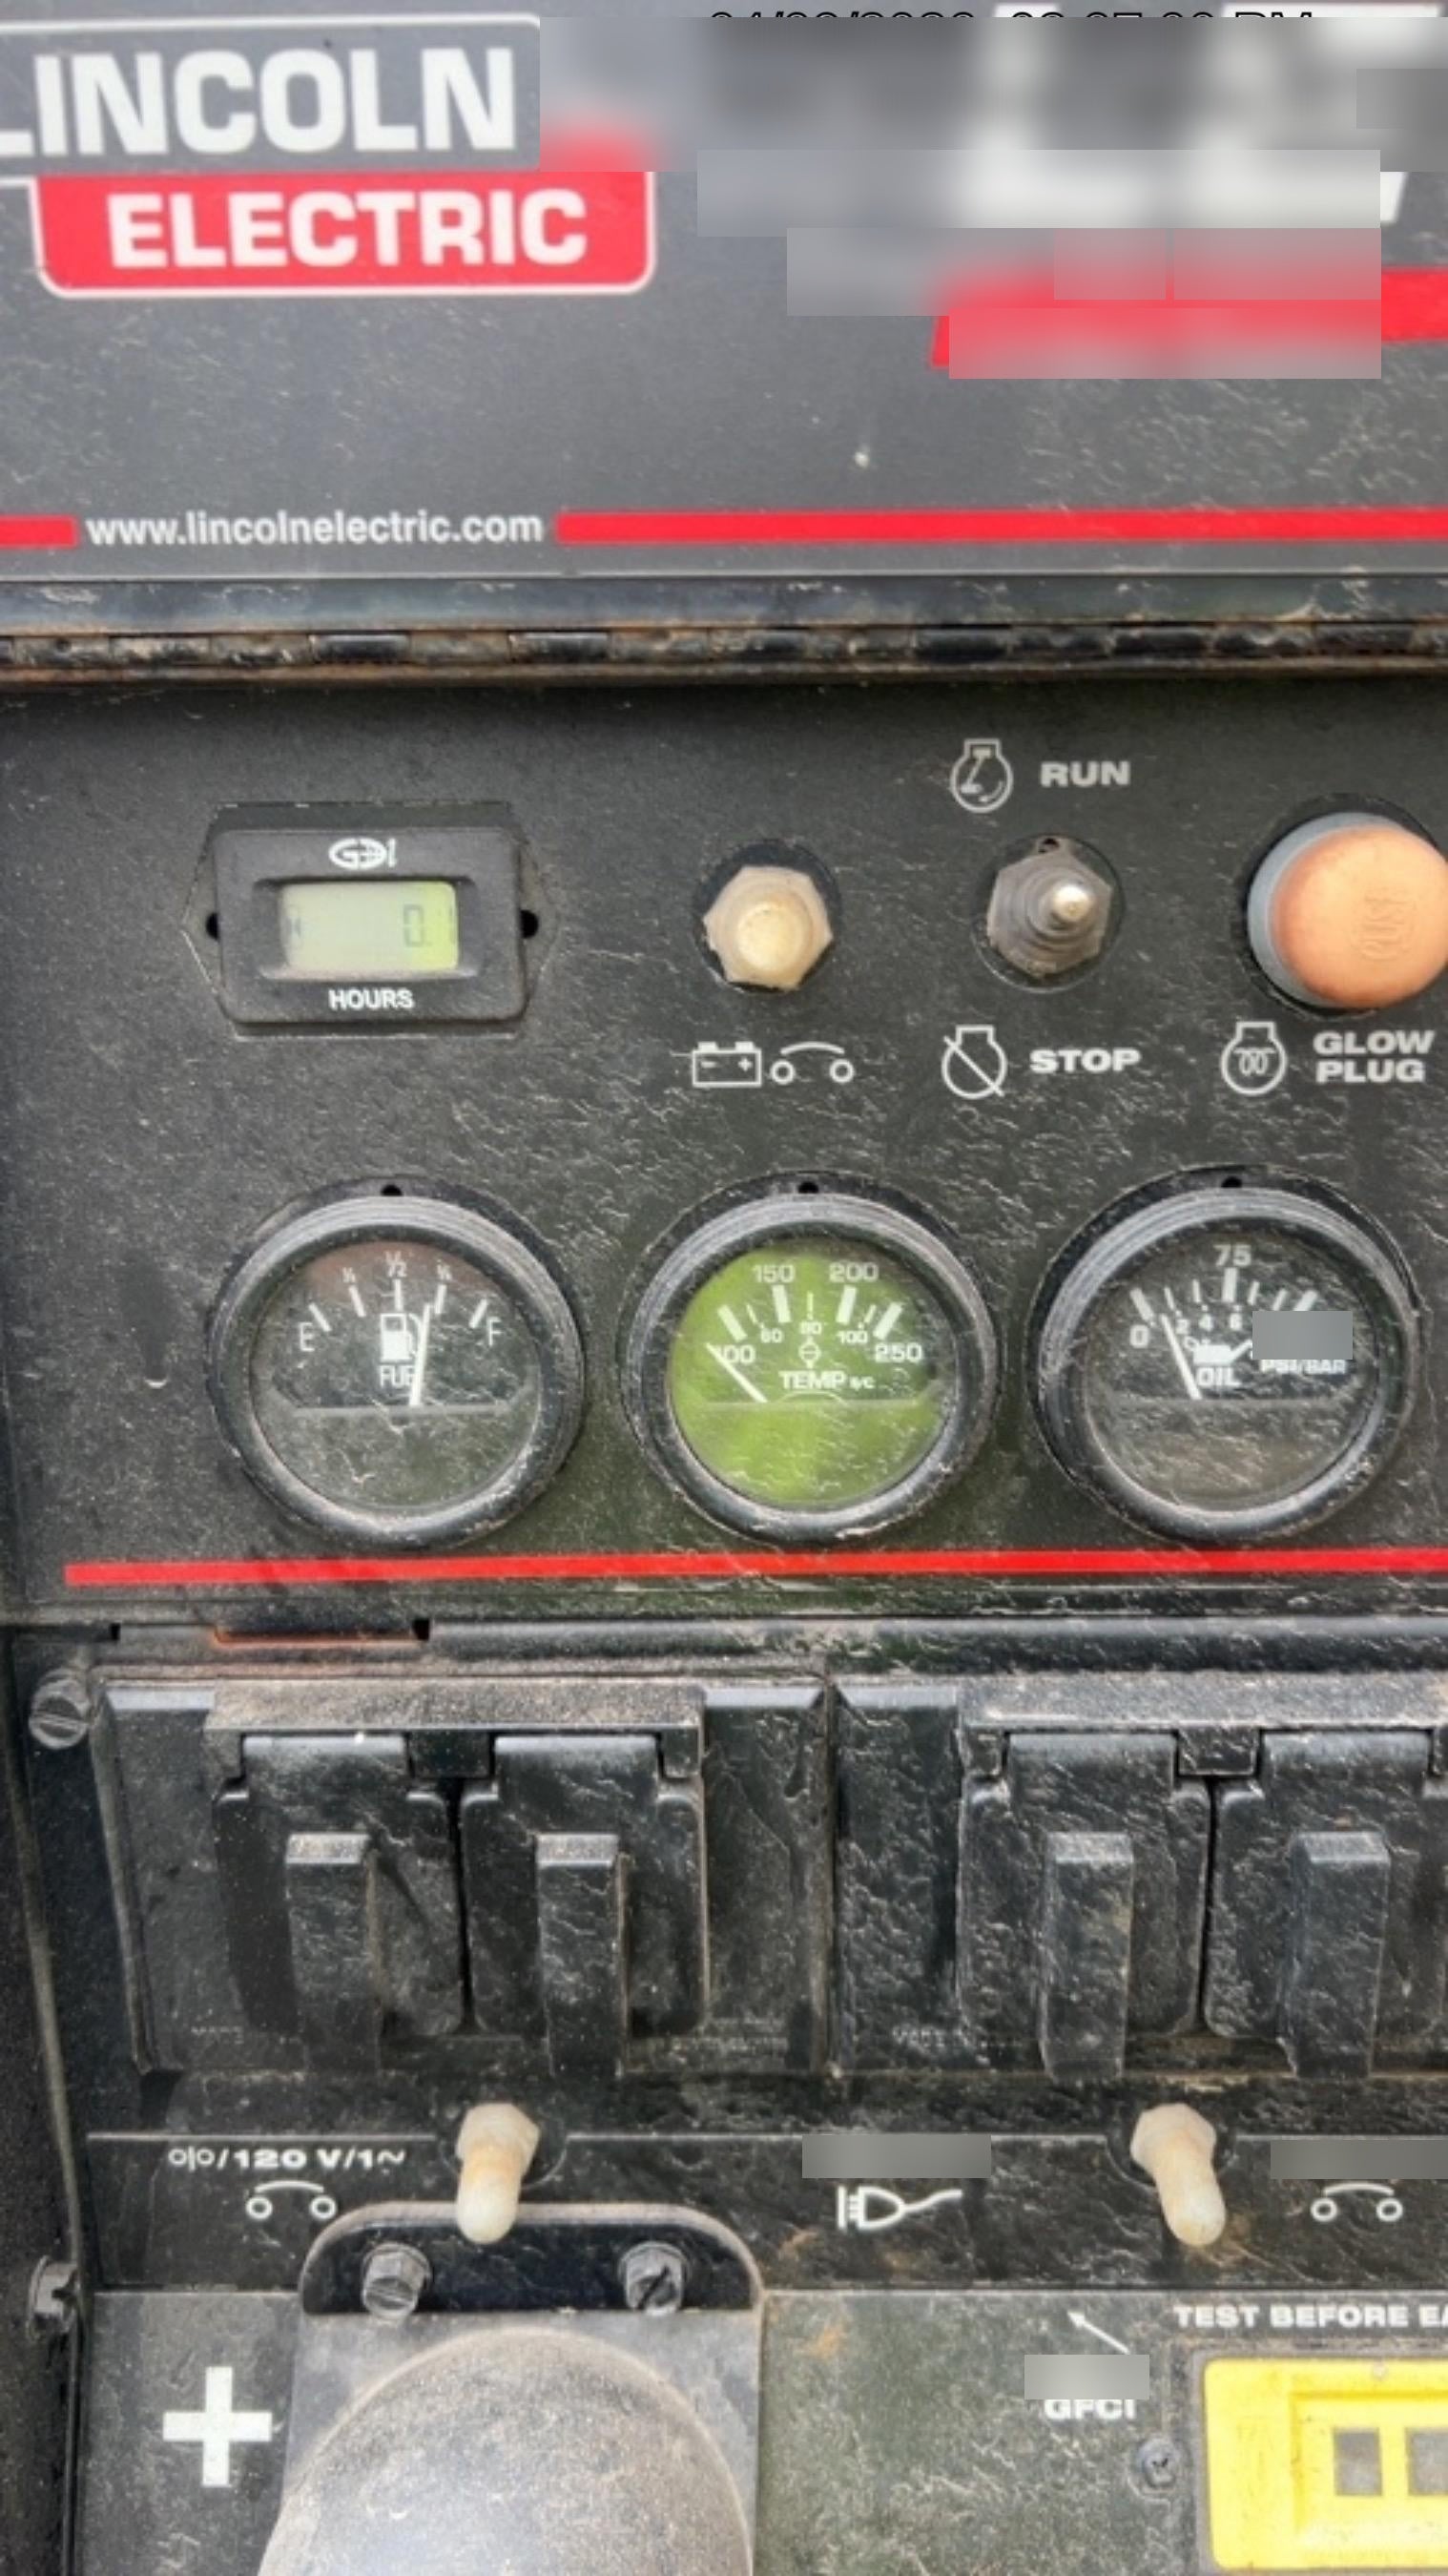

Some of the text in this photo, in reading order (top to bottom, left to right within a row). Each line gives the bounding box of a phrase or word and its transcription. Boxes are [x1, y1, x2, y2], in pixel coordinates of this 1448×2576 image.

[107, 190, 588, 269] ELECTRIC
[87, 509, 544, 549] www.lincolnelectric.com
[1041, 760, 1130, 787] RUN
[328, 988, 415, 1010] HOURS
[1313, 1030, 1436, 1055] GLOW
[1029, 1049, 1142, 1074] STOP
[1315, 1059, 1425, 1084] PLUG
[1213, 1244, 1251, 1266] 75
[753, 1263, 796, 1283] 150
[829, 1262, 879, 1282] 200
[300, 1321, 316, 1352] E
[486, 1317, 503, 1347] F
[1128, 1324, 1150, 1349] 0
[716, 1343, 755, 1364] 00
[874, 1341, 923, 1363] 250
[379, 1364, 415, 1388] FUE
[777, 1370, 846, 1390] TEMP
[1195, 1366, 1241, 1388] OIL
[1172, 2303, 1260, 2329] TEST
[1269, 2303, 1410, 2329] BEFORE
